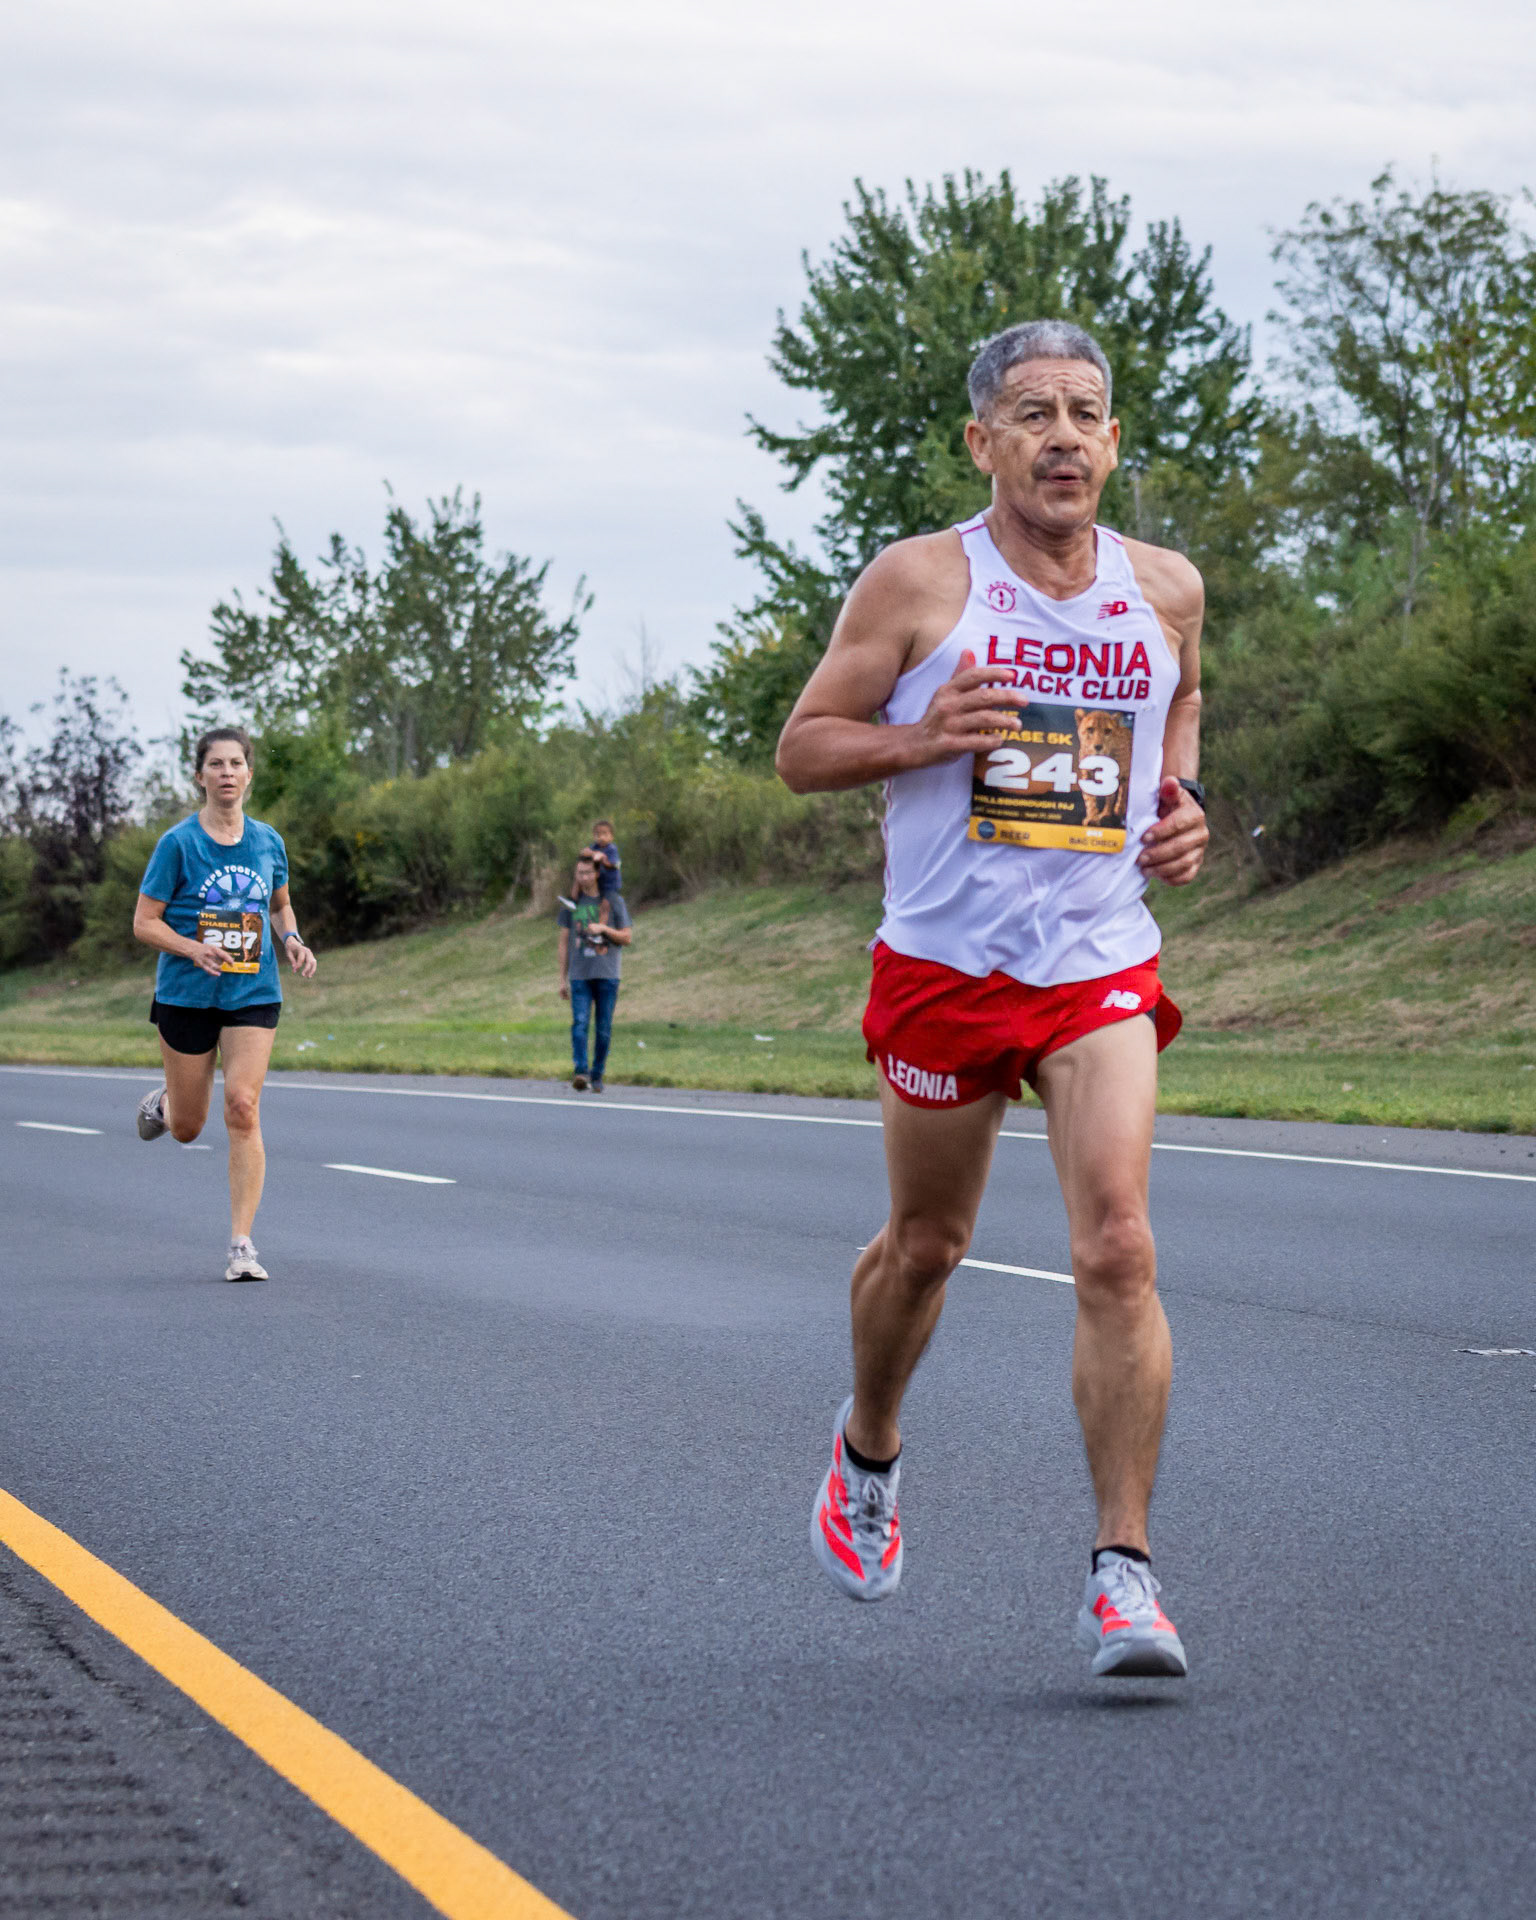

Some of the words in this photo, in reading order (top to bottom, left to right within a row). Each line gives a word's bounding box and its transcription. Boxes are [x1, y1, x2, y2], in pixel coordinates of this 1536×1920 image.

[987, 635, 1152, 677] LEONIA
[986, 667, 1075, 697] RACK
[1081, 680, 1150, 700] CLUB
[980, 728, 1045, 744] HASE
[985, 747, 1120, 796] 243
[203, 929, 258, 949] 287
[887, 1053, 959, 1101] LEONIA
